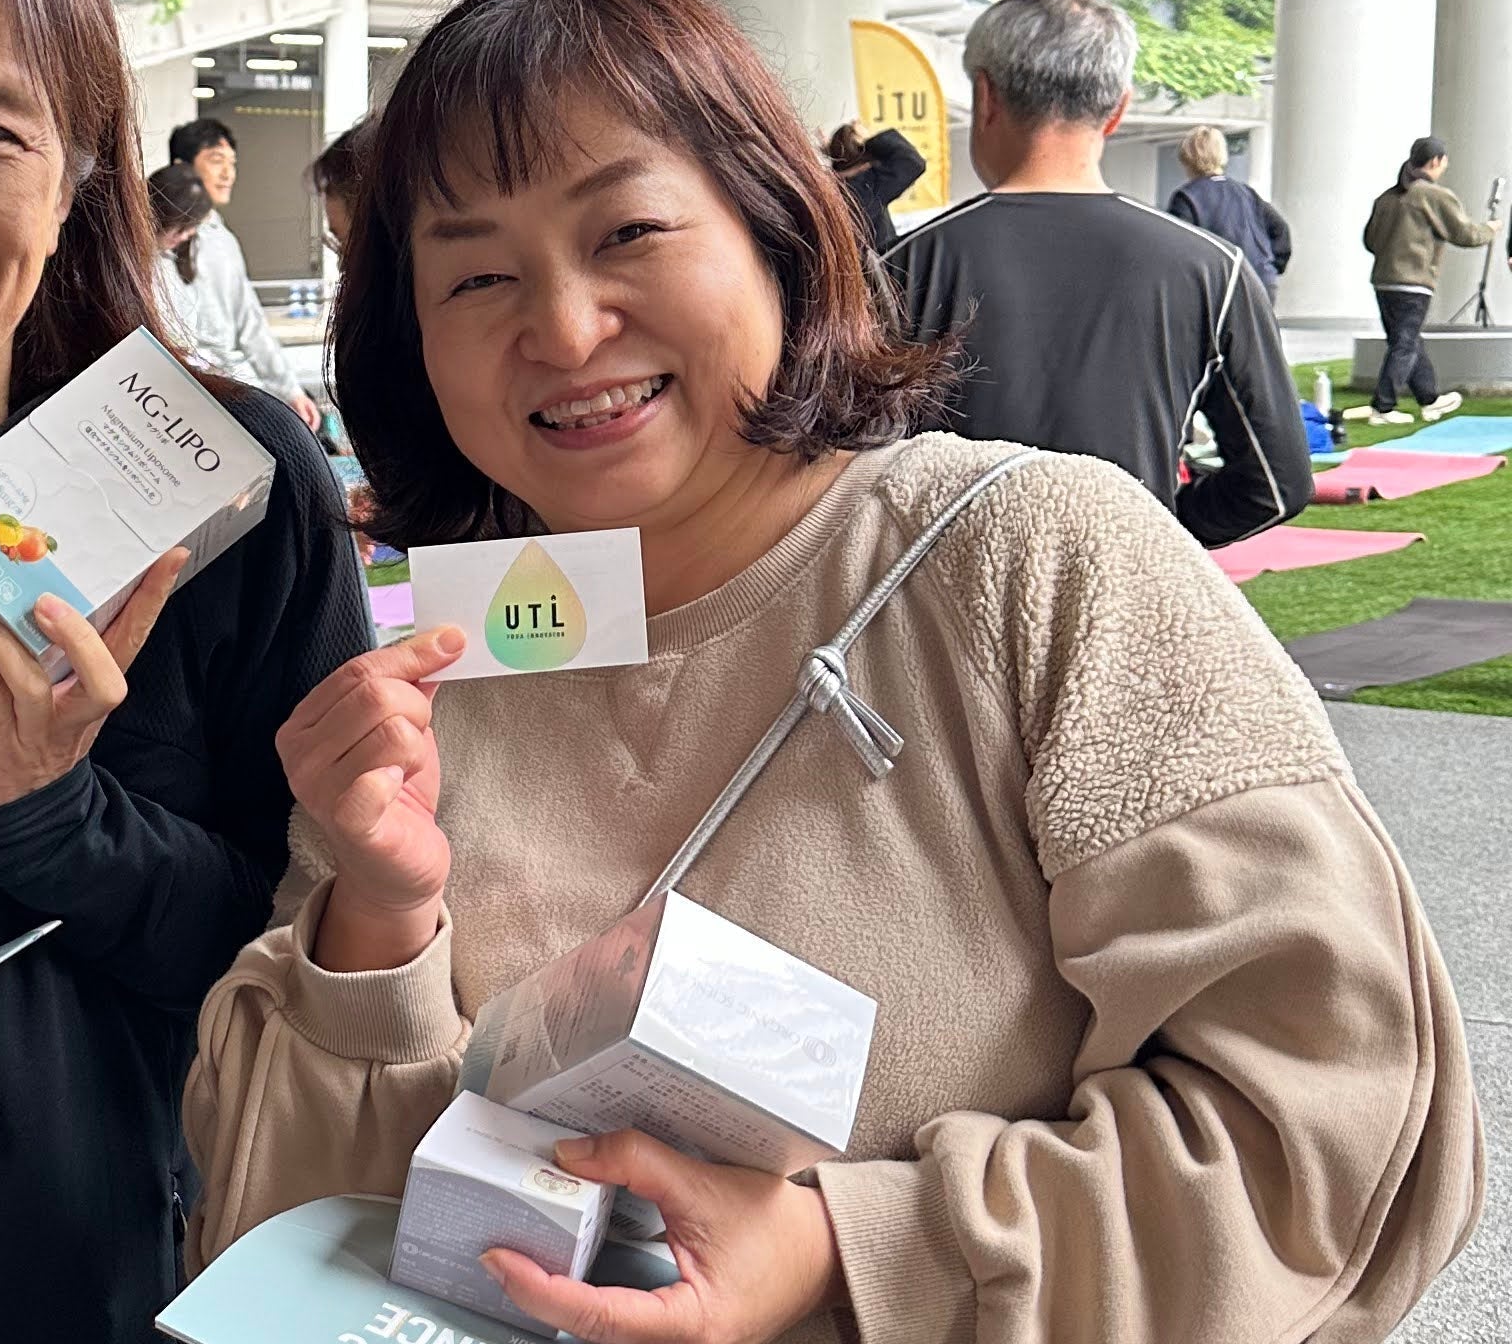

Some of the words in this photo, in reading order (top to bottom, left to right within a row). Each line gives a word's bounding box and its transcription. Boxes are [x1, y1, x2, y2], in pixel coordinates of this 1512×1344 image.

[100, 404, 146, 452] Magnesium
[118, 371, 222, 473] MG-LIPO
[146, 421, 171, 445] マグリポ
[102, 423, 162, 485] マグネシウムリポソーム
